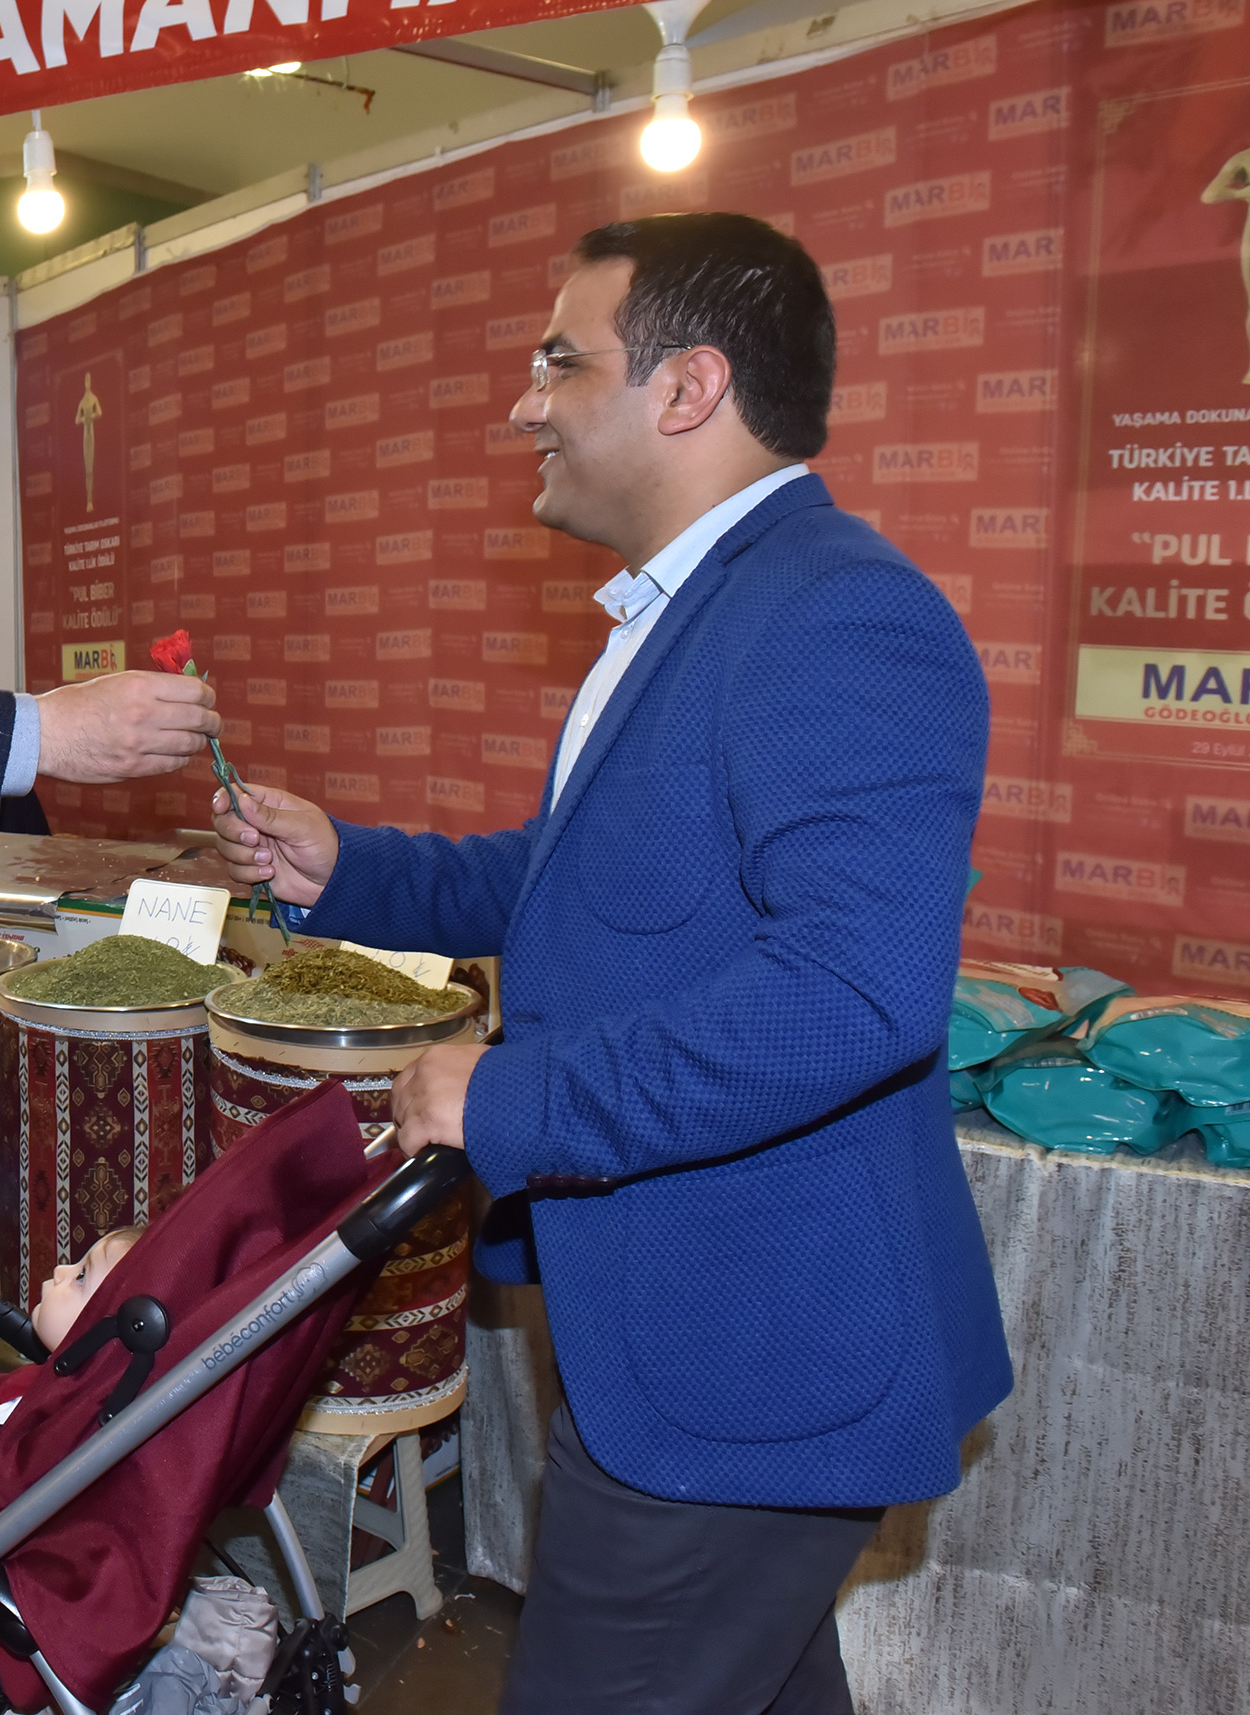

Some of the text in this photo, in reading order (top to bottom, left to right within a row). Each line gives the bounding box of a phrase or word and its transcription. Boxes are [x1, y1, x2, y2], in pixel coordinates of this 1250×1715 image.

[1112, 411, 1181, 429] YAŞAMA
[1108, 441, 1215, 469] TÜRKİYE
[1132, 475, 1220, 502] KALİTE
[1089, 579, 1230, 621] KALİTE
[1191, 802, 1250, 828] MA
[138, 896, 212, 925] NANE
